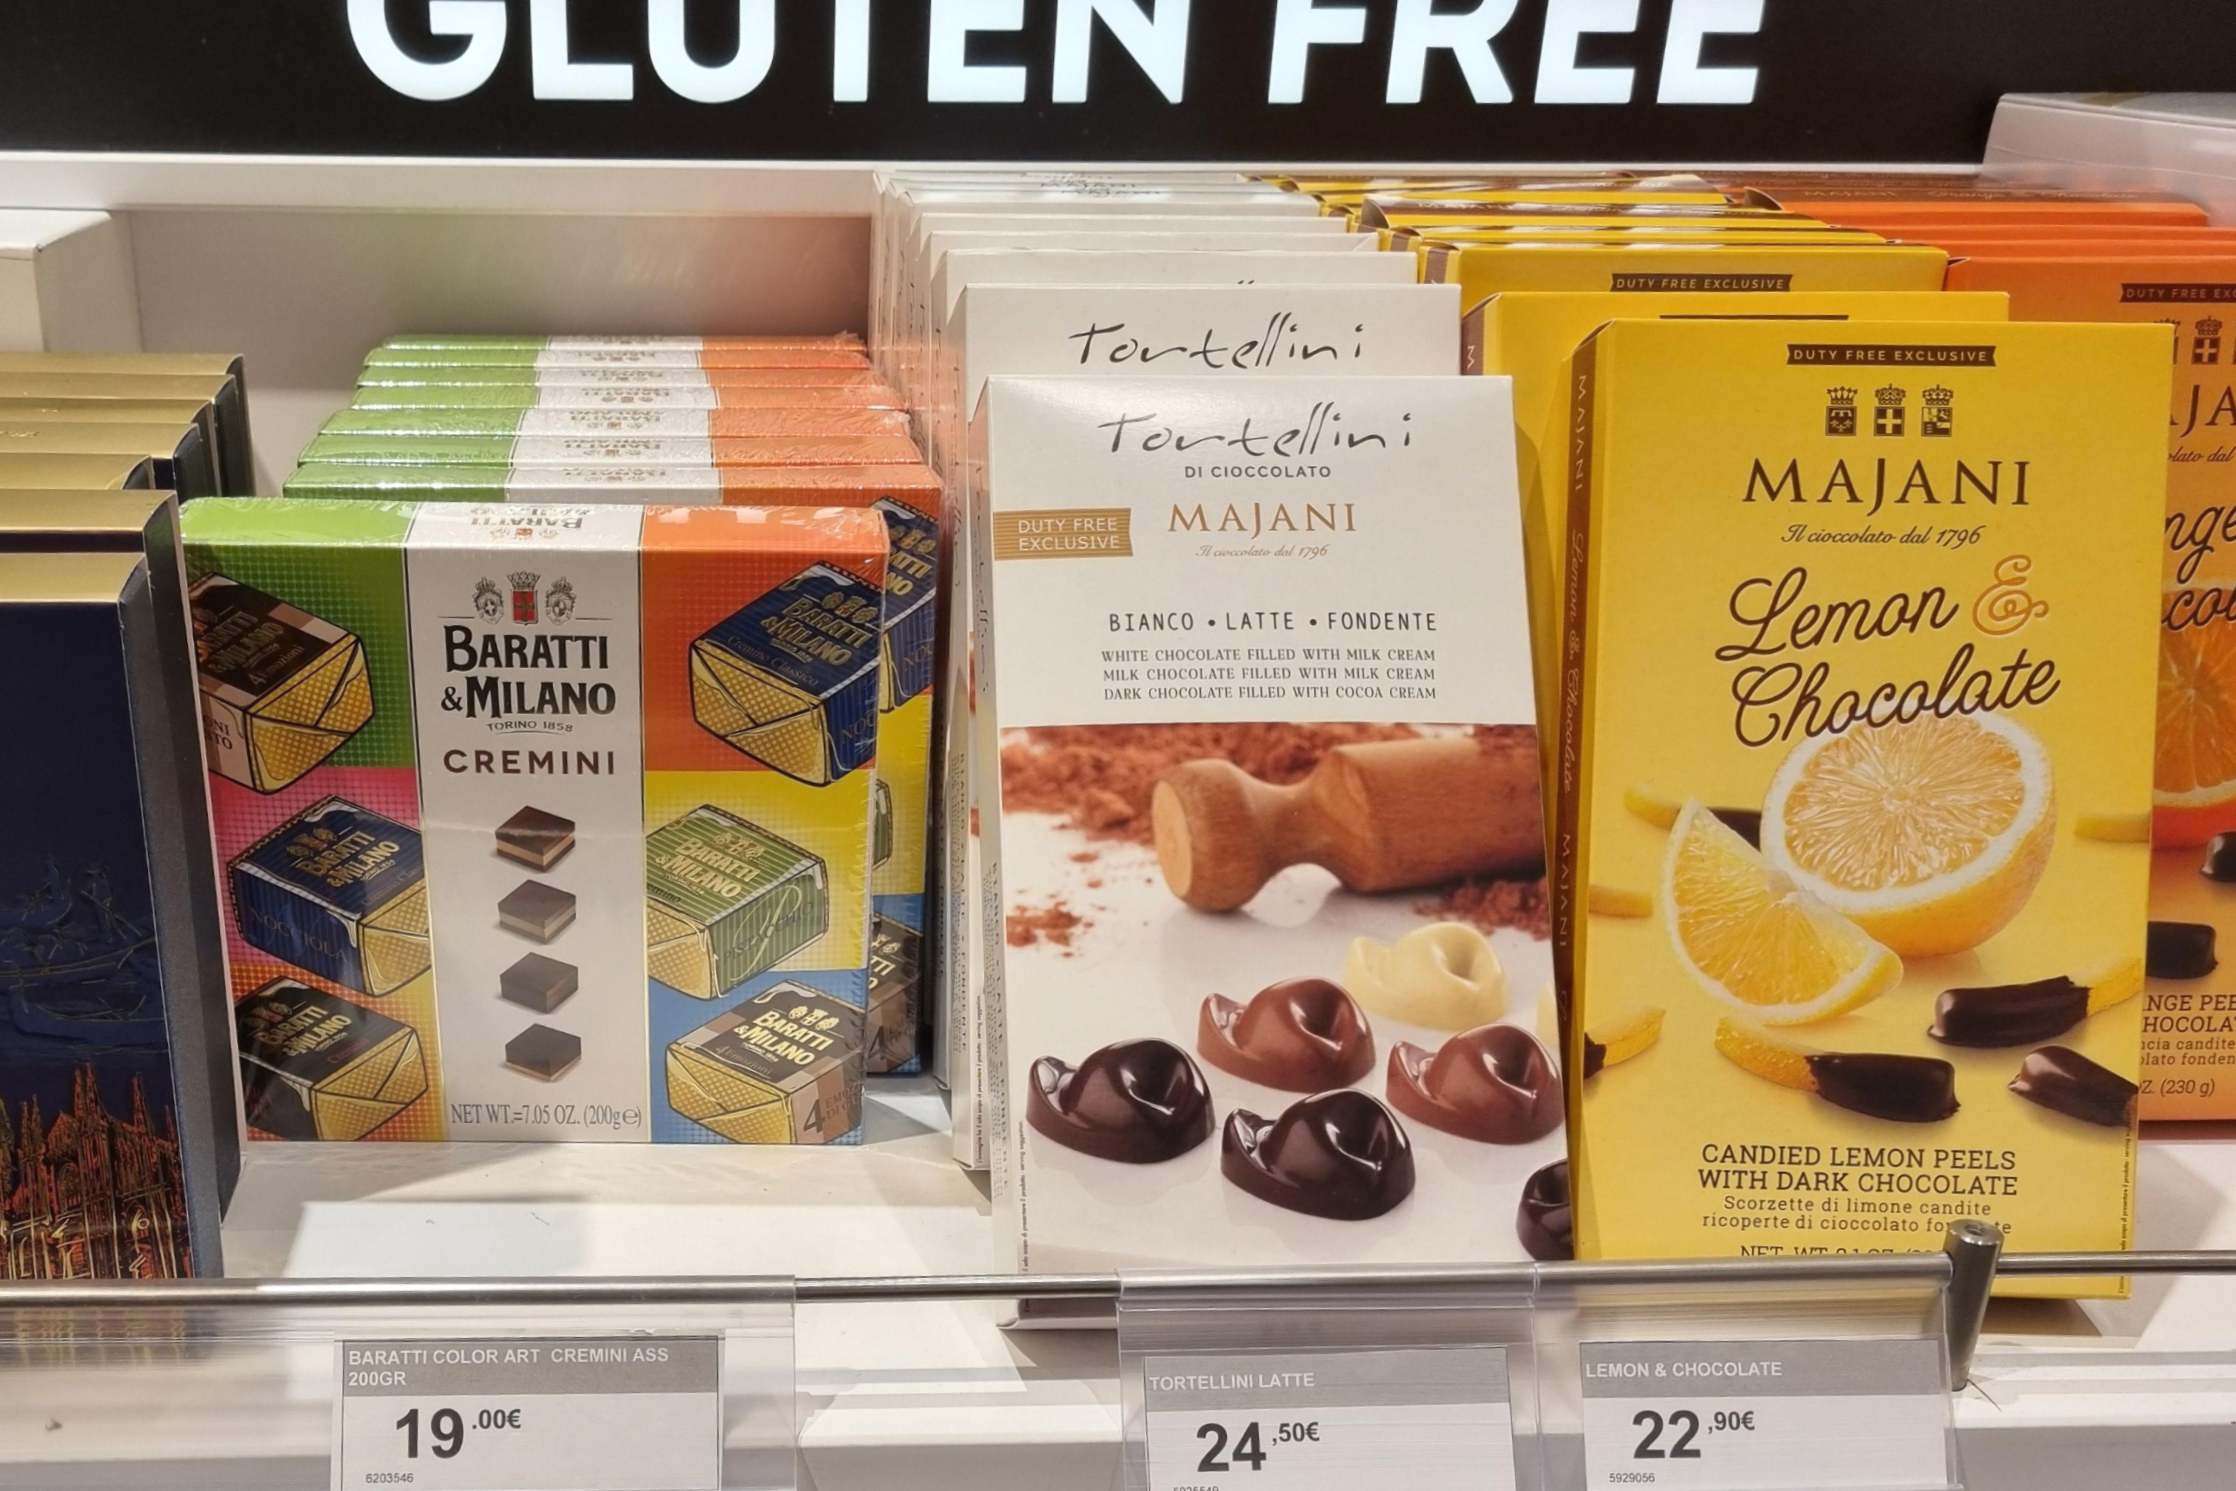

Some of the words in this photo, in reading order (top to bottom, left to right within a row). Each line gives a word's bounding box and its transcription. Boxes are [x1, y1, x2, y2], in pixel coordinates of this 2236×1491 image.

[1266, 0, 1765, 105] FREE
[1616, 277, 1655, 290] DUTY
[1661, 277, 1698, 290] FREE
[1703, 277, 1785, 291] EXCLUSIVE
[2126, 288, 2166, 299] DUTY
[2171, 288, 2207, 299] FREE
[1068, 312, 1365, 369] Tortellini
[1793, 349, 1838, 361] DUTY
[1845, 350, 1887, 362] FREE
[1894, 350, 1988, 363] EXCLUSIVE
[1097, 401, 1411, 457] Tortellini
[1574, 374, 1588, 491] MAJANI
[2207, 447, 2234, 462] dal
[1184, 466, 1204, 478] DI
[1211, 465, 1331, 479] CIOCCOLATO
[1741, 457, 2031, 517] MAJANI
[1018, 518, 1066, 534] DUTY
[1073, 516, 1118, 532] FREE
[1167, 502, 1358, 540] MAJANI
[1019, 534, 1121, 551] EXCLUSIVE
[1807, 524, 1898, 544] cioccolato
[1899, 525, 1930, 544] dal
[1937, 525, 1987, 550] 1796
[1213, 544, 1272, 558] cioccolato
[1297, 543, 1330, 560] 1796
[782, 597, 874, 649] BARATTI
[1109, 612, 1195, 632] BIANCO
[1226, 612, 1295, 631] LATTE
[1328, 611, 1438, 631] FONDENTE
[1714, 566, 1960, 662] Lemon
[443, 624, 609, 673] BARATTI
[759, 615, 853, 666] &MILANO
[727, 635, 771, 662] Cremino
[770, 655, 819, 687] Classico
[1102, 649, 1149, 662] WHITE
[1154, 649, 1241, 662] CHOCOLATE
[1247, 649, 1296, 662] FILLED
[1302, 648, 1341, 661] WITH
[1346, 648, 1381, 661] MILK
[1387, 648, 1436, 661] CREAM
[1103, 668, 1140, 681] MILK
[1147, 667, 1235, 681] CHOCOLATE
[1241, 667, 1292, 680] FILLED
[1298, 667, 1337, 680] WITH
[1343, 667, 1380, 680] MILK
[1386, 667, 1435, 680] CREAM
[440, 675, 617, 719] &MILANO
[1104, 687, 1142, 700] DARK
[1148, 687, 1233, 700] CHOCOLATE
[1238, 686, 1286, 699] FILLED
[1292, 686, 1330, 699] WITH
[1335, 686, 1383, 699] COCOA
[1389, 686, 1436, 699] CREAM
[1731, 642, 2062, 748] Chocolate
[486, 720, 538, 732] TORINO
[543, 721, 574, 733] 1858
[1563, 667, 1580, 795] Chocolate
[443, 749, 615, 775] CREMINI
[296, 829, 377, 878] BARATTI
[326, 840, 401, 889] &MILANO
[675, 837, 761, 883] BARATTI
[655, 853, 743, 898] &MILANO
[1559, 833, 1571, 947] MAJANI
[250, 906, 349, 964] NOCCIOLA
[733, 1024, 817, 1066] &MILANO
[752, 1010, 836, 1052] BARATTI
[2160, 1079, 2196, 1097] (230
[2199, 1079, 2215, 1097] g)
[450, 1104, 483, 1124] NET
[554, 1103, 581, 1125] OZ.
[803, 1098, 826, 1134] 4
[1701, 1143, 1822, 1166] CANDIED
[1829, 1146, 1925, 1168] LEMON
[1933, 1149, 2017, 1171] PEELS
[1698, 1168, 1768, 1190] WITH
[1775, 1171, 1850, 1192] DARK
[1857, 1173, 2018, 1196] CHOCOLATE
[1723, 1195, 1815, 1212] Scorzette
[1821, 1197, 1839, 1213] di
[1846, 1198, 1912, 1214] limone
[1919, 1200, 1992, 1216] candite
[1702, 1214, 1790, 1231] ricoperte
[1795, 1214, 1813, 1230] di
[1820, 1215, 1920, 1232] cioccolato
[349, 1350, 428, 1366] BARATTI
[432, 1349, 499, 1365] COLOR
[504, 1349, 541, 1364] ART
[550, 1348, 627, 1363] CREMINI
[632, 1348, 669, 1363] ASS
[1586, 1363, 1649, 1378] LEMON
[1655, 1363, 1667, 1378] &
[1672, 1361, 1782, 1377] CHOCOLATE
[348, 1371, 407, 1386] 200GR
[1149, 1375, 1254, 1391] TORTELLINI
[1258, 1373, 1315, 1388] LATTE
[395, 1408, 465, 1459] 19
[1196, 1421, 1267, 1472] 24
[1632, 1409, 1701, 1459] 22
[365, 1473, 414, 1484] 6203546
[1608, 1473, 1656, 1483] 5929056
